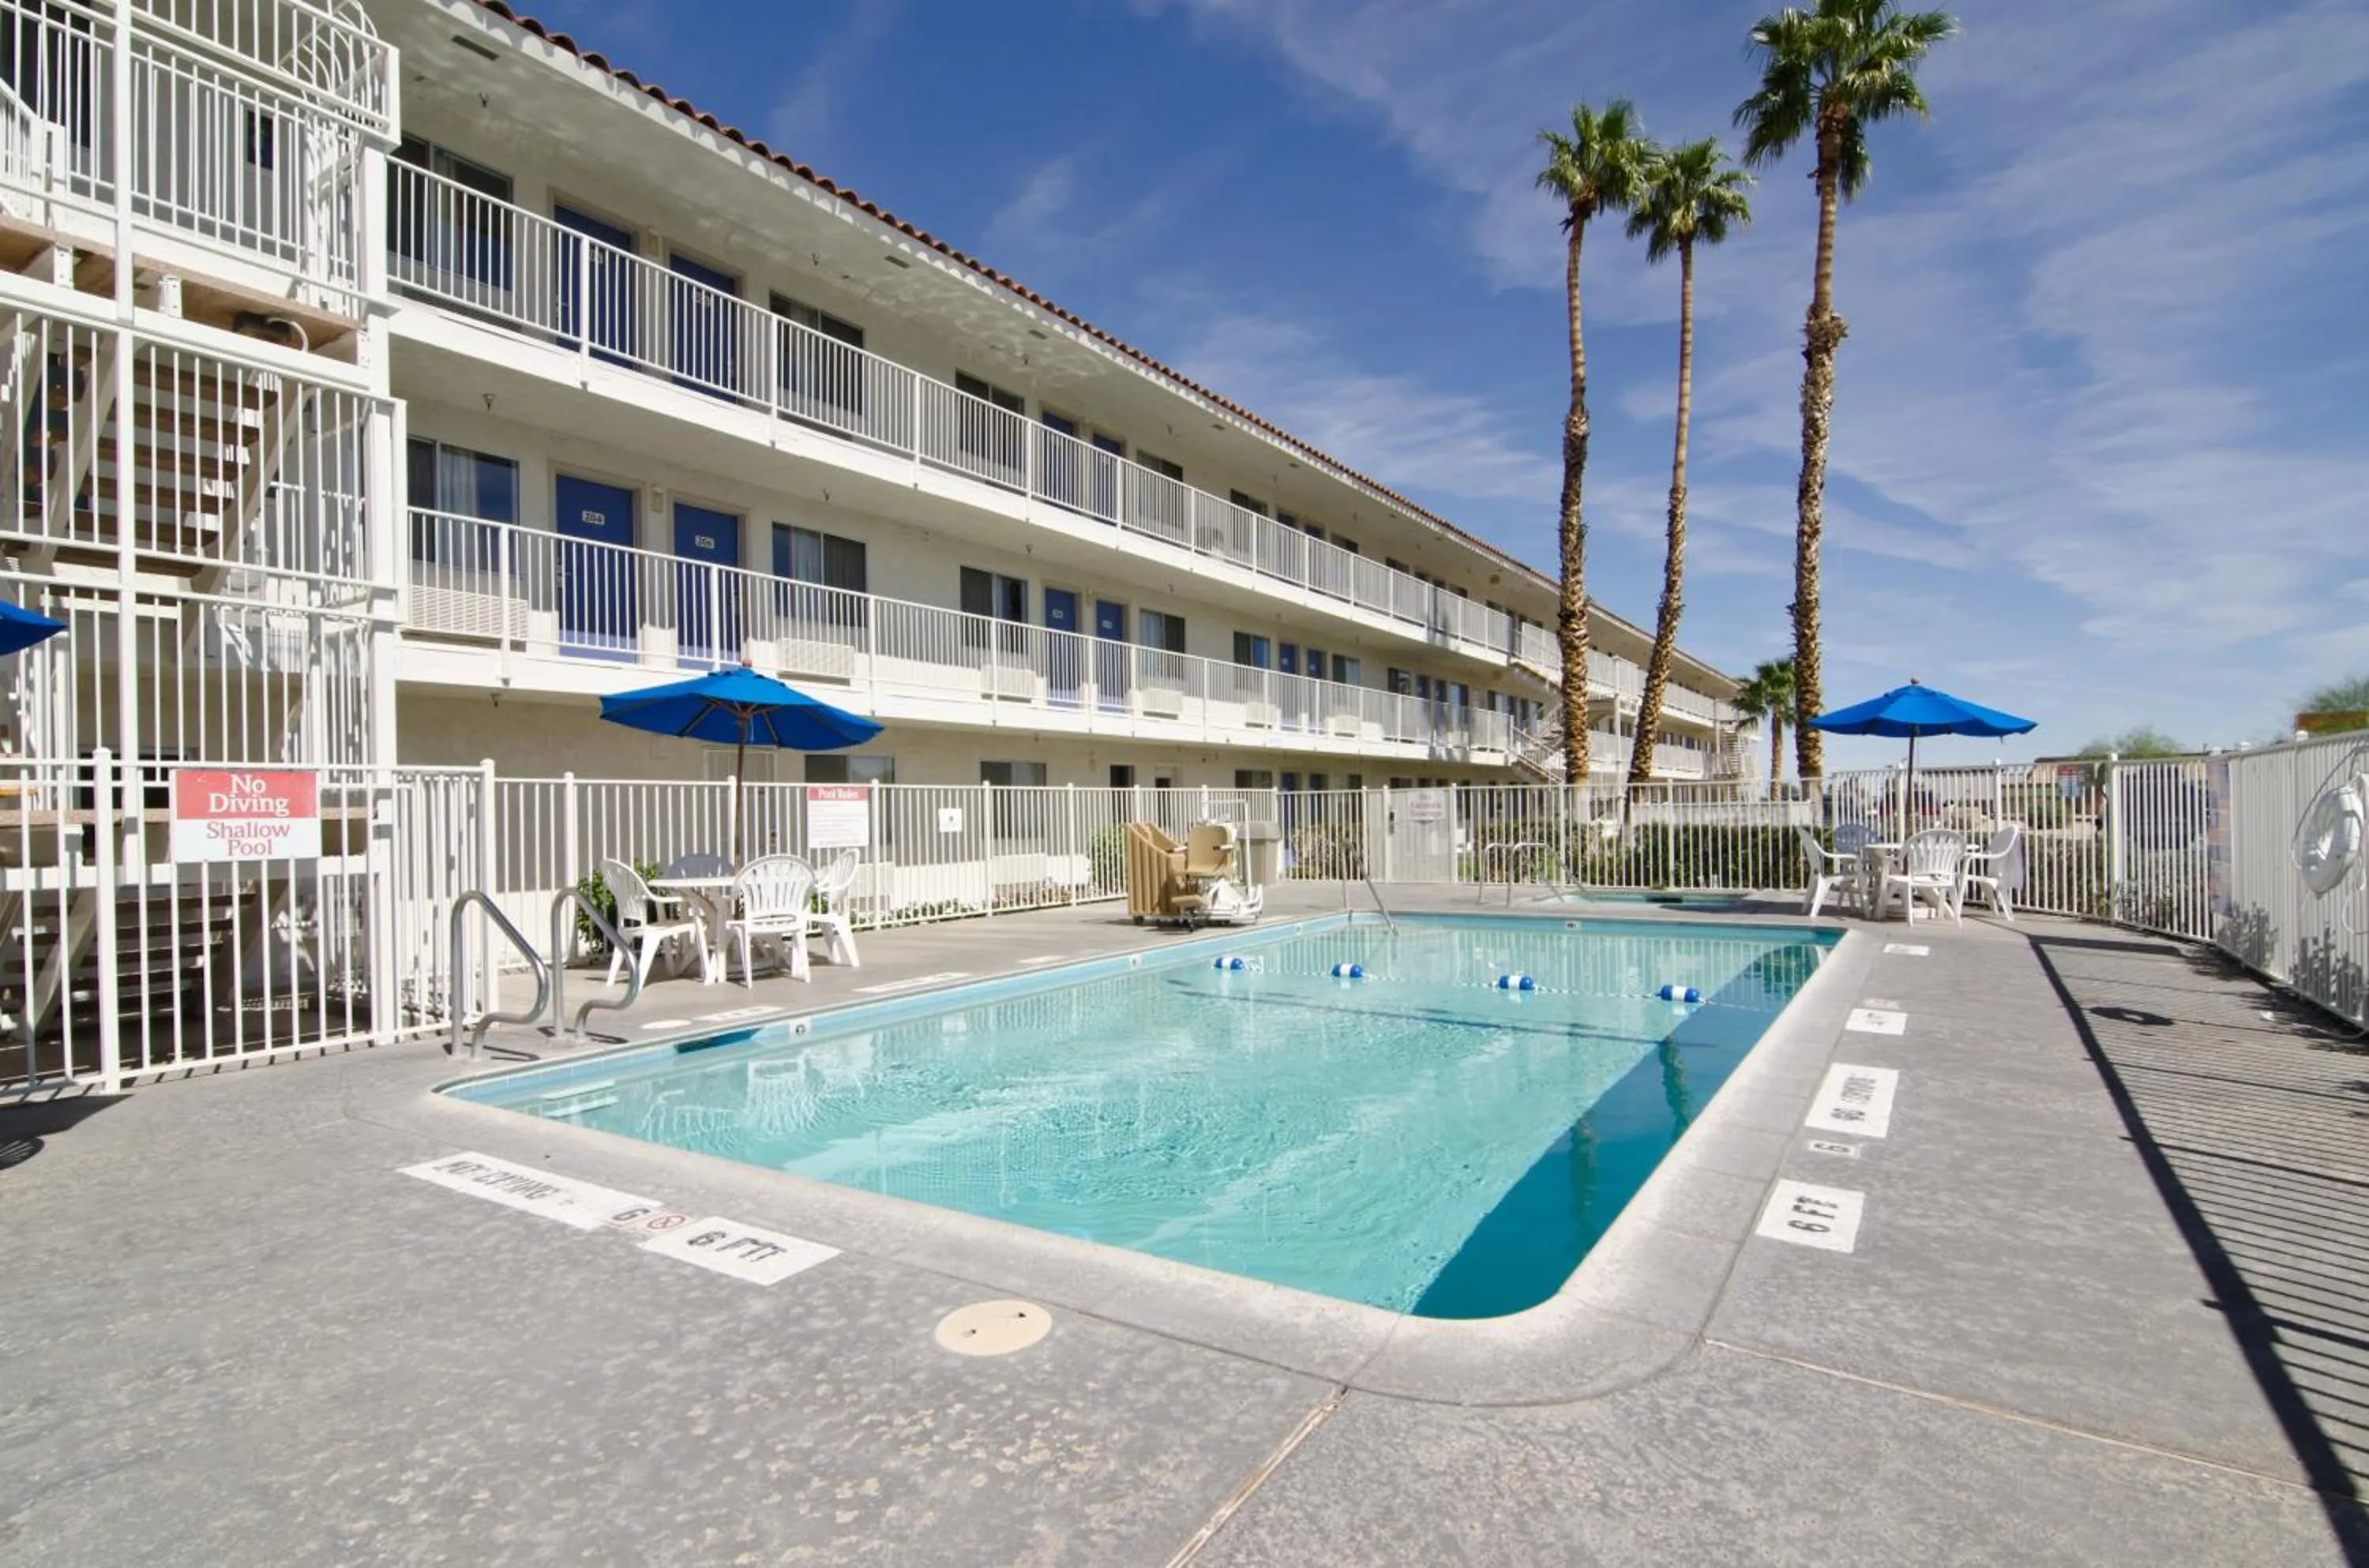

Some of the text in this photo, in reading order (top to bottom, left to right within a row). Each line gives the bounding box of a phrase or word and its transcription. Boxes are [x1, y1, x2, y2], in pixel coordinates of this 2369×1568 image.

[230, 773, 266, 793] No
[208, 793, 290, 817] Diving
[206, 821, 291, 839] Shallow
[227, 838, 273, 857] Pool
[1788, 1220, 1831, 1232] 6
[686, 1230, 726, 1246] 6
